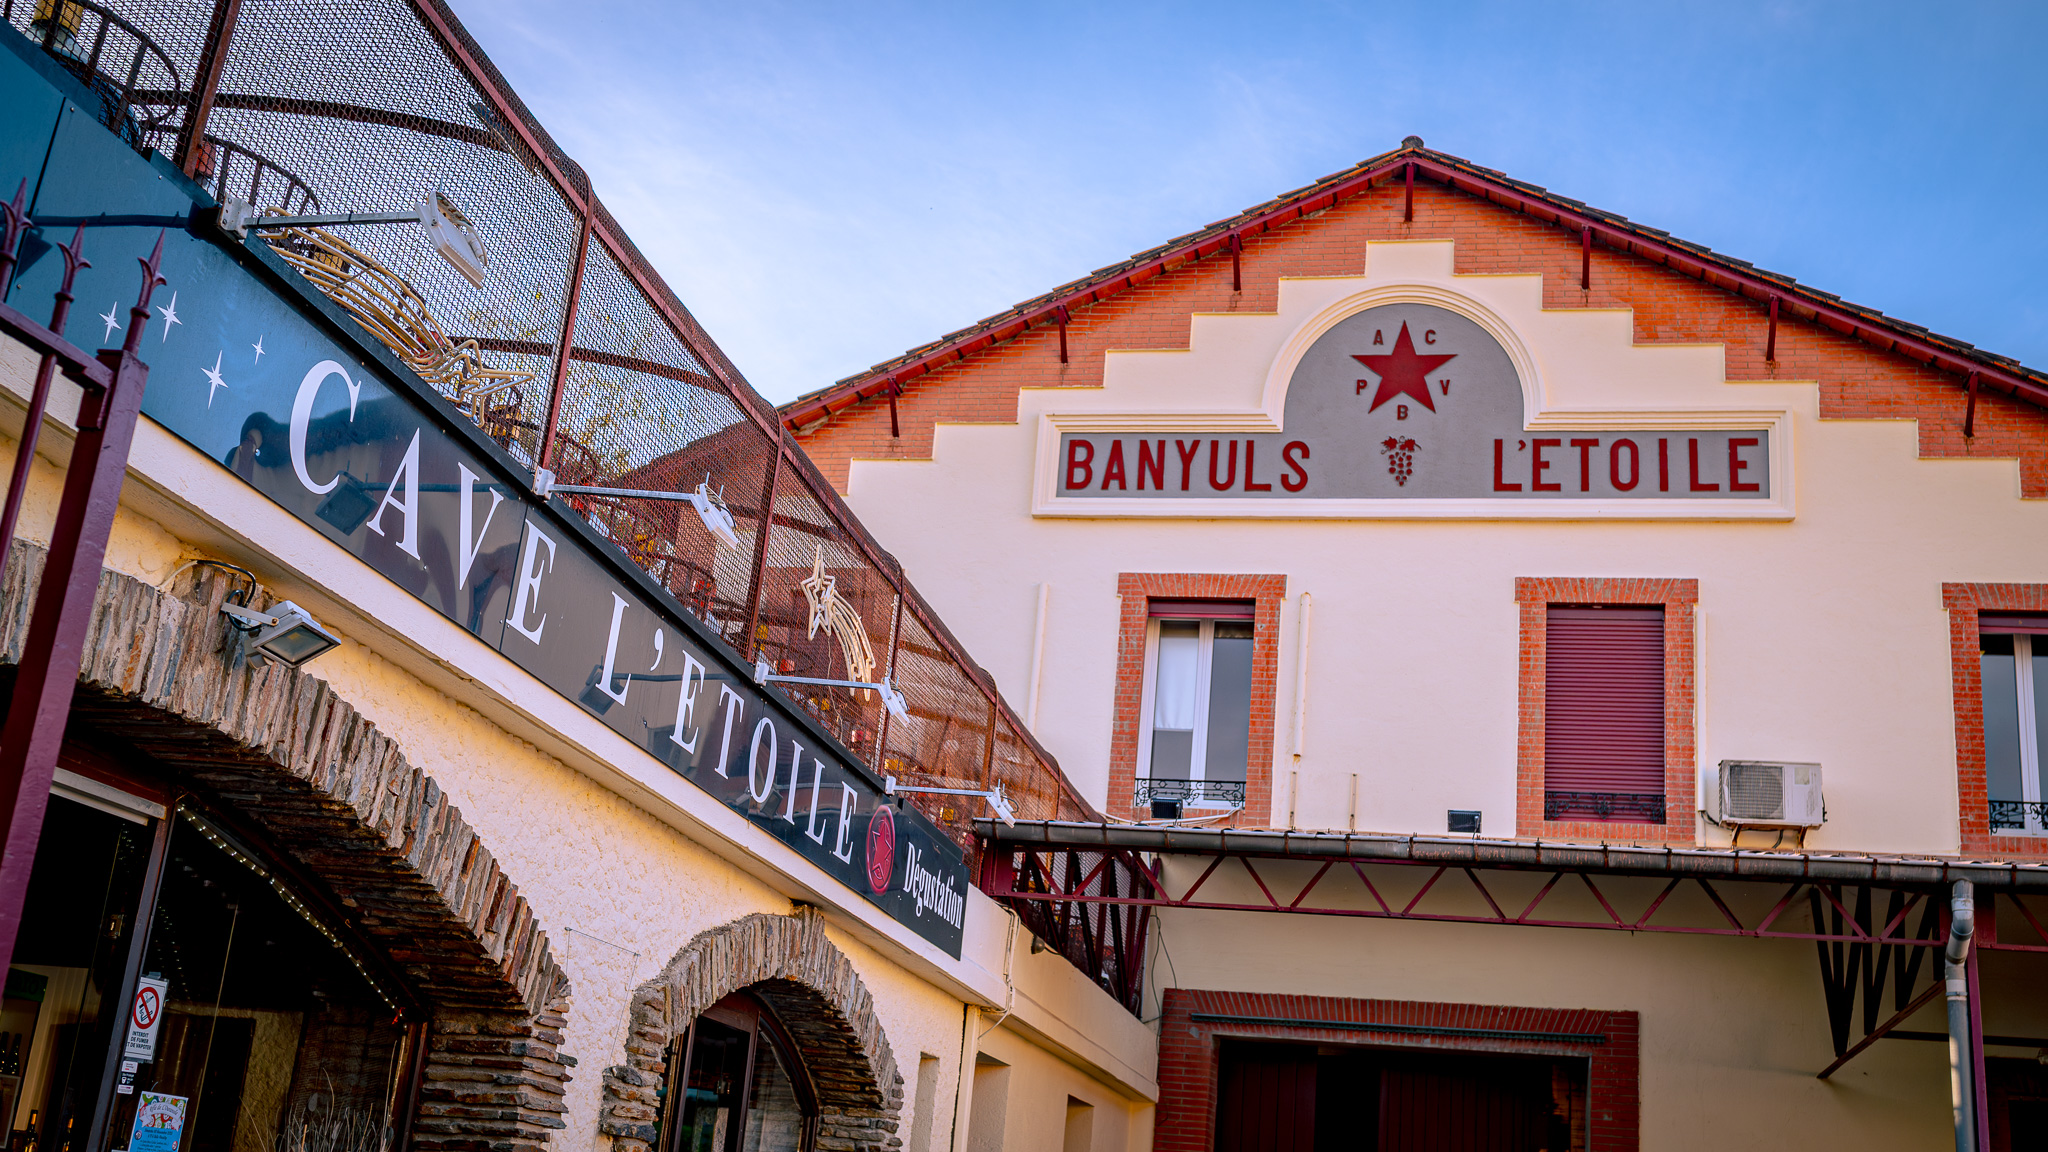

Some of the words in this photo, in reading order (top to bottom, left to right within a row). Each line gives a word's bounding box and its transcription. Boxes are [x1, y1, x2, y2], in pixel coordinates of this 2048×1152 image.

[1373, 329, 1384, 345] A
[1425, 329, 1436, 345] C
[1356, 379, 1368, 395] P
[1439, 379, 1450, 396] V
[1397, 404, 1408, 420] B
[1066, 439, 1310, 492] BANYULS
[1493, 438, 1760, 492] L'ETOILE
[289, 360, 557, 645] CAVE
[595, 591, 858, 865] L'ETOILE
[903, 842, 963, 929] Dégustation
